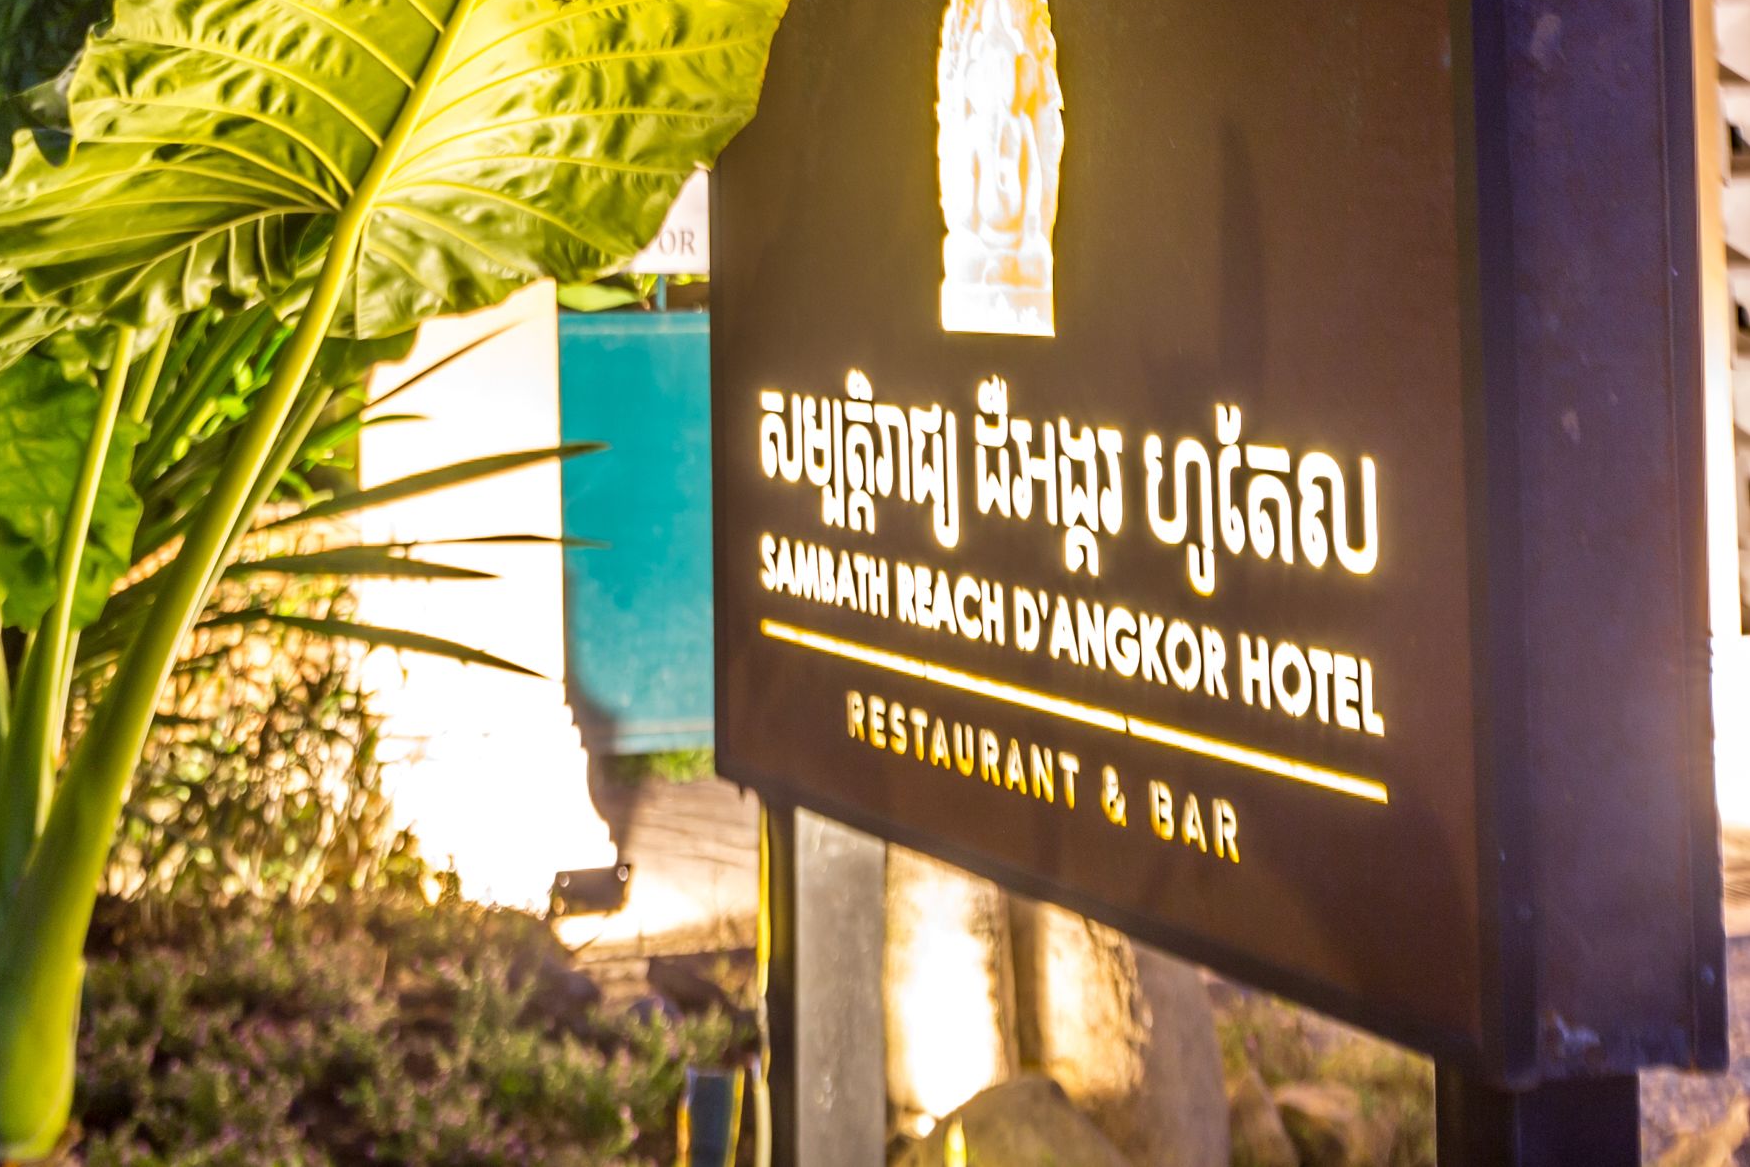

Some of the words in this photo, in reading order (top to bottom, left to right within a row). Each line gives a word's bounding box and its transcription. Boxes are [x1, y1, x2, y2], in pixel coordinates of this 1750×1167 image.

[1143, 402, 1379, 597] ហូតែល
[760, 532, 889, 619] SAMBATH
[896, 561, 1006, 646] REACH
[1013, 586, 1230, 700] D'ANGKOR
[1239, 633, 1385, 737] HOTEL
[847, 691, 1080, 808] RESTAURANT
[1102, 766, 1127, 827] &
[1149, 781, 1240, 863] BAR
